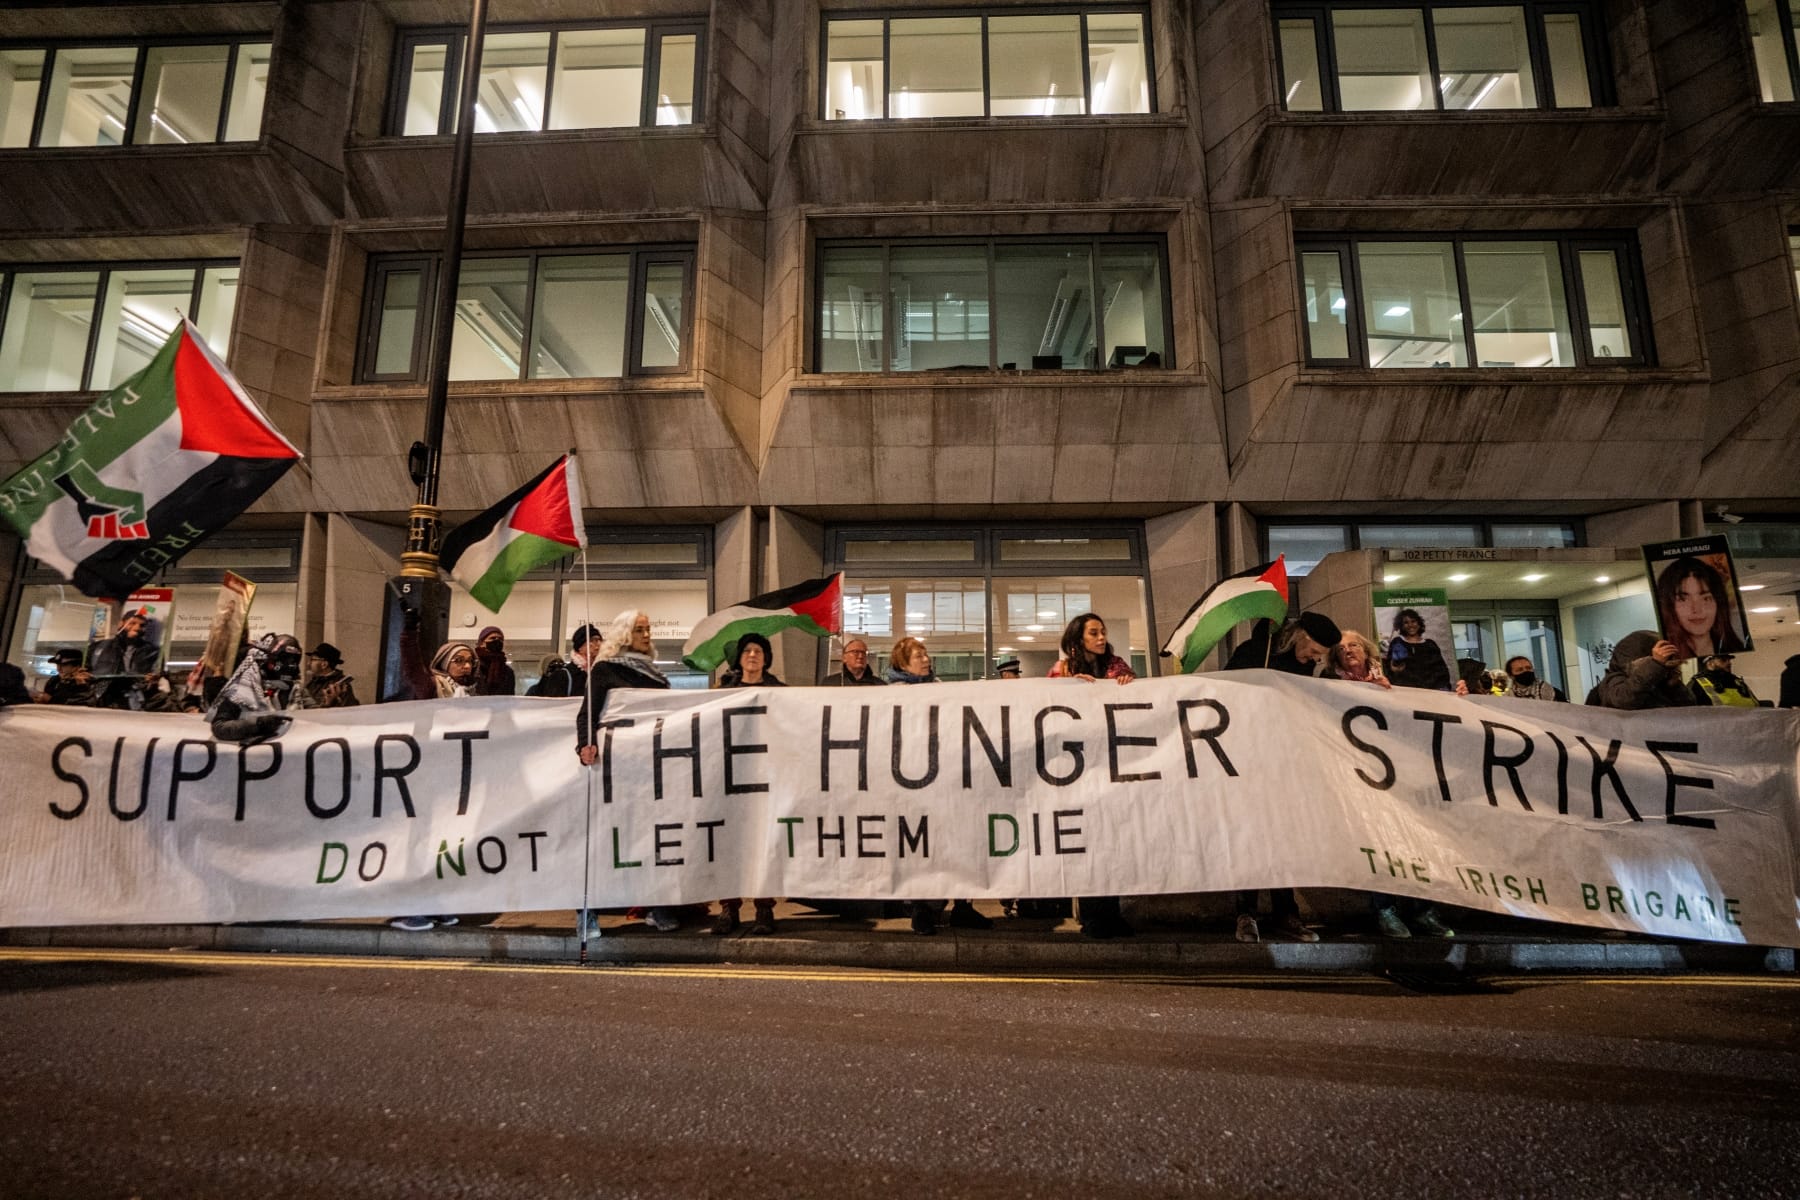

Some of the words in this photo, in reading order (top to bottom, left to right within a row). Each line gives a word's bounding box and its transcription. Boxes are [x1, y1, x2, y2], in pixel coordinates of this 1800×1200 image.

[0, 386, 141, 514] PALESINE
[122, 521, 206, 581] FREE
[402, 583, 411, 593] 5
[1403, 550, 1420, 560] 102
[1422, 550, 1454, 560] PETTY
[1456, 550, 1497, 560] FRANCE
[49, 730, 489, 821] SUPPORT
[598, 705, 770, 804] THE
[819, 698, 1239, 792] HUNGER
[1341, 705, 1717, 830] STRIKE
[315, 840, 388, 884] DO
[436, 831, 548, 880] NOT
[612, 817, 725, 870] LET
[777, 814, 931, 859] THEM
[988, 809, 1087, 858] DIE
[1360, 847, 1431, 884] THE
[1455, 866, 1549, 906] IRISH
[1581, 883, 1743, 927] BRIGADE
